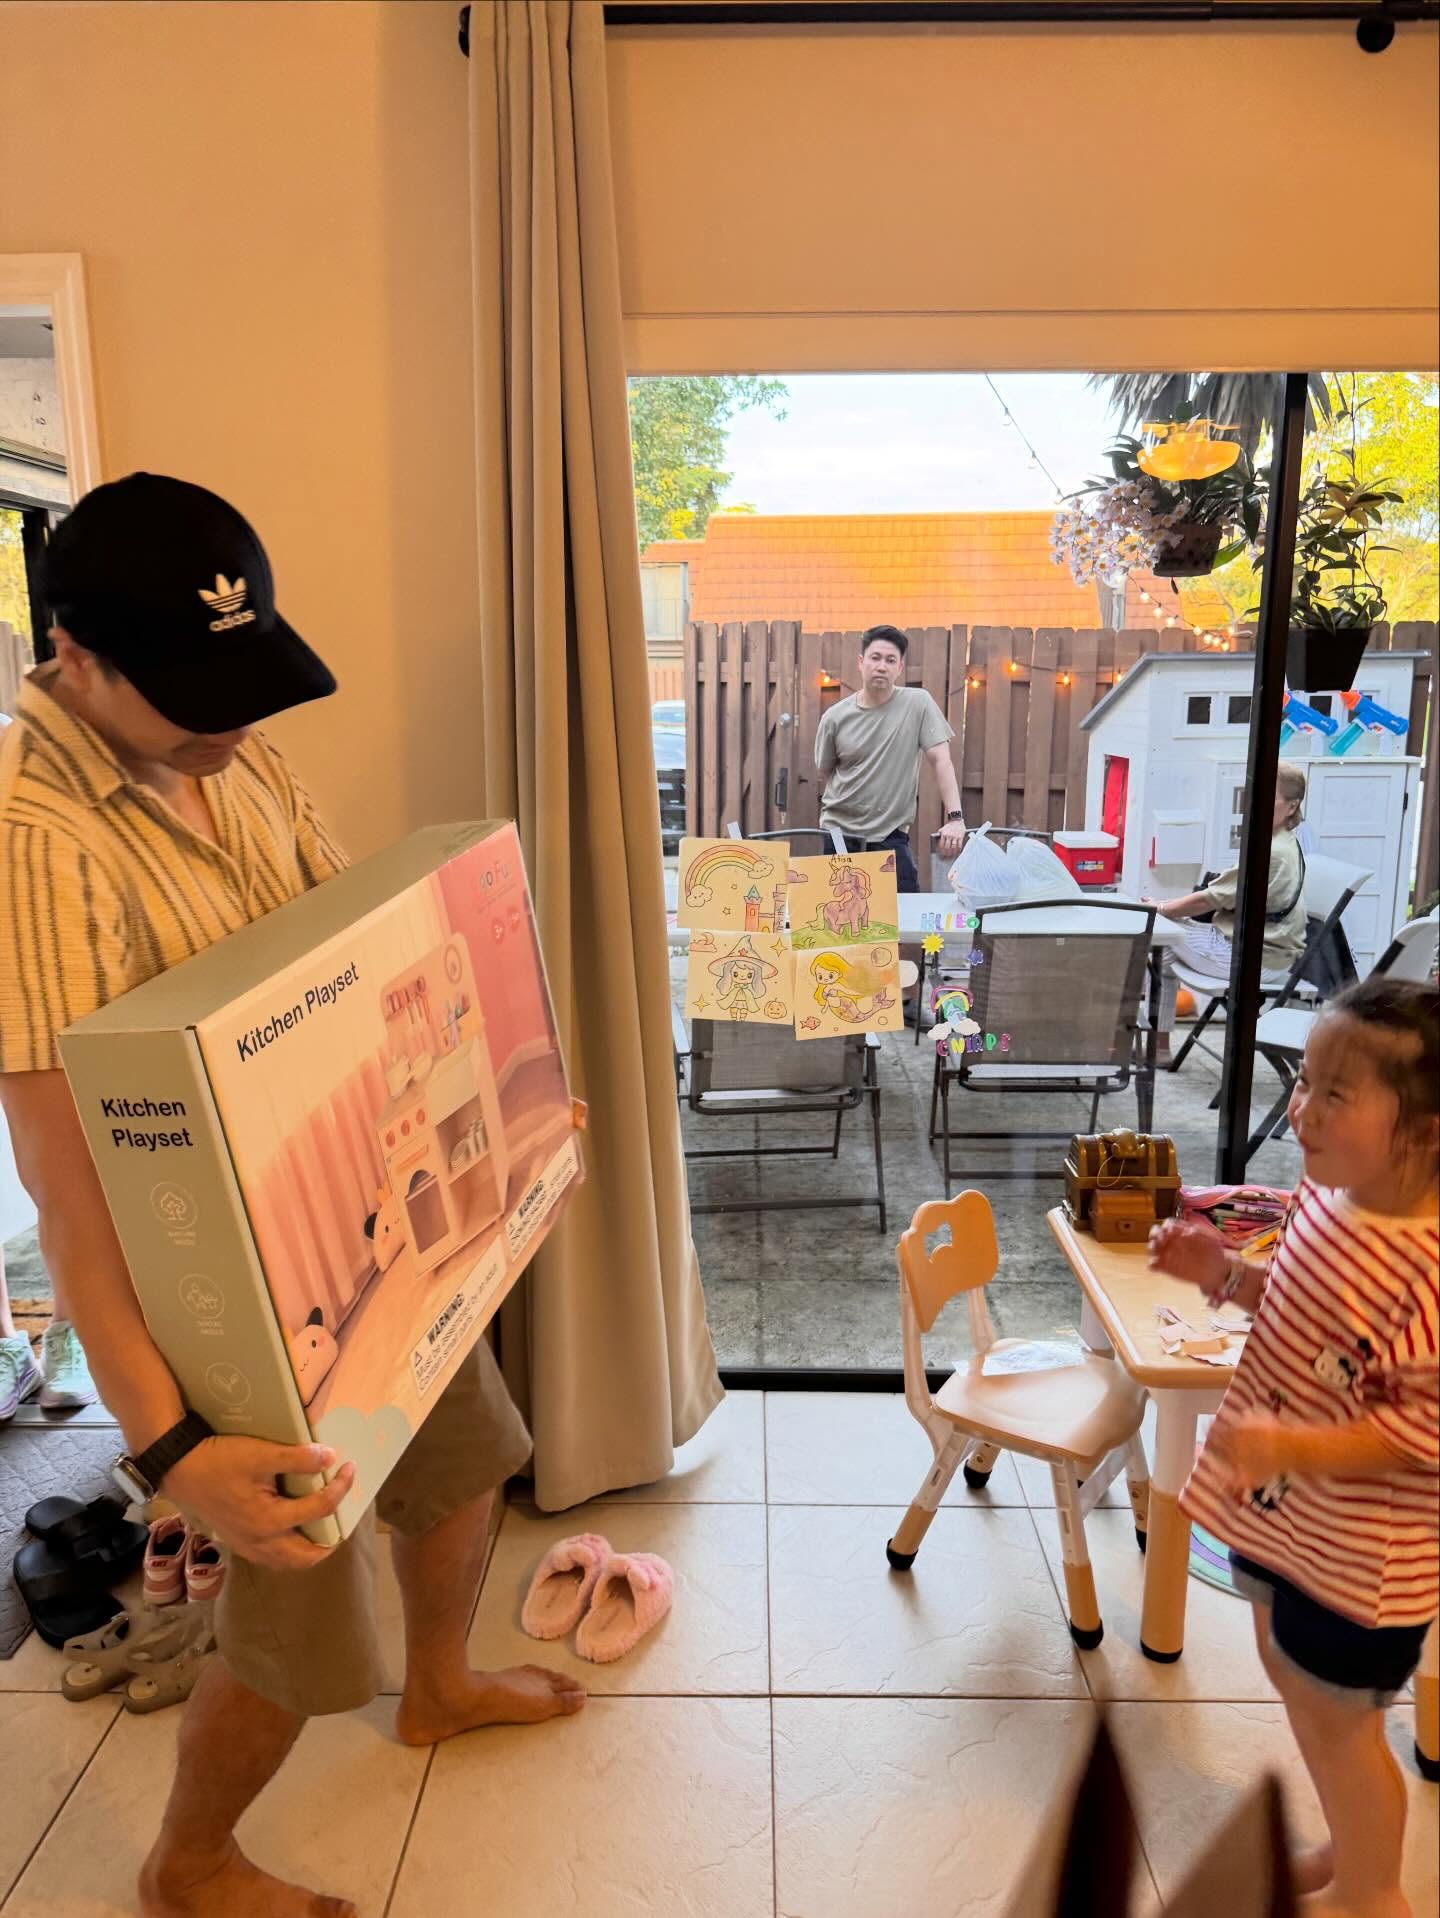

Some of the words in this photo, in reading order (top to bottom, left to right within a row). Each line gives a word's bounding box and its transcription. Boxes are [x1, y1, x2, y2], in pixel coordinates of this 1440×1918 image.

[236, 1005, 305, 1062] Kitchen
[304, 961, 360, 1014] Playset
[100, 1098, 186, 1118] Kitchen
[111, 1128, 194, 1151] Playset
